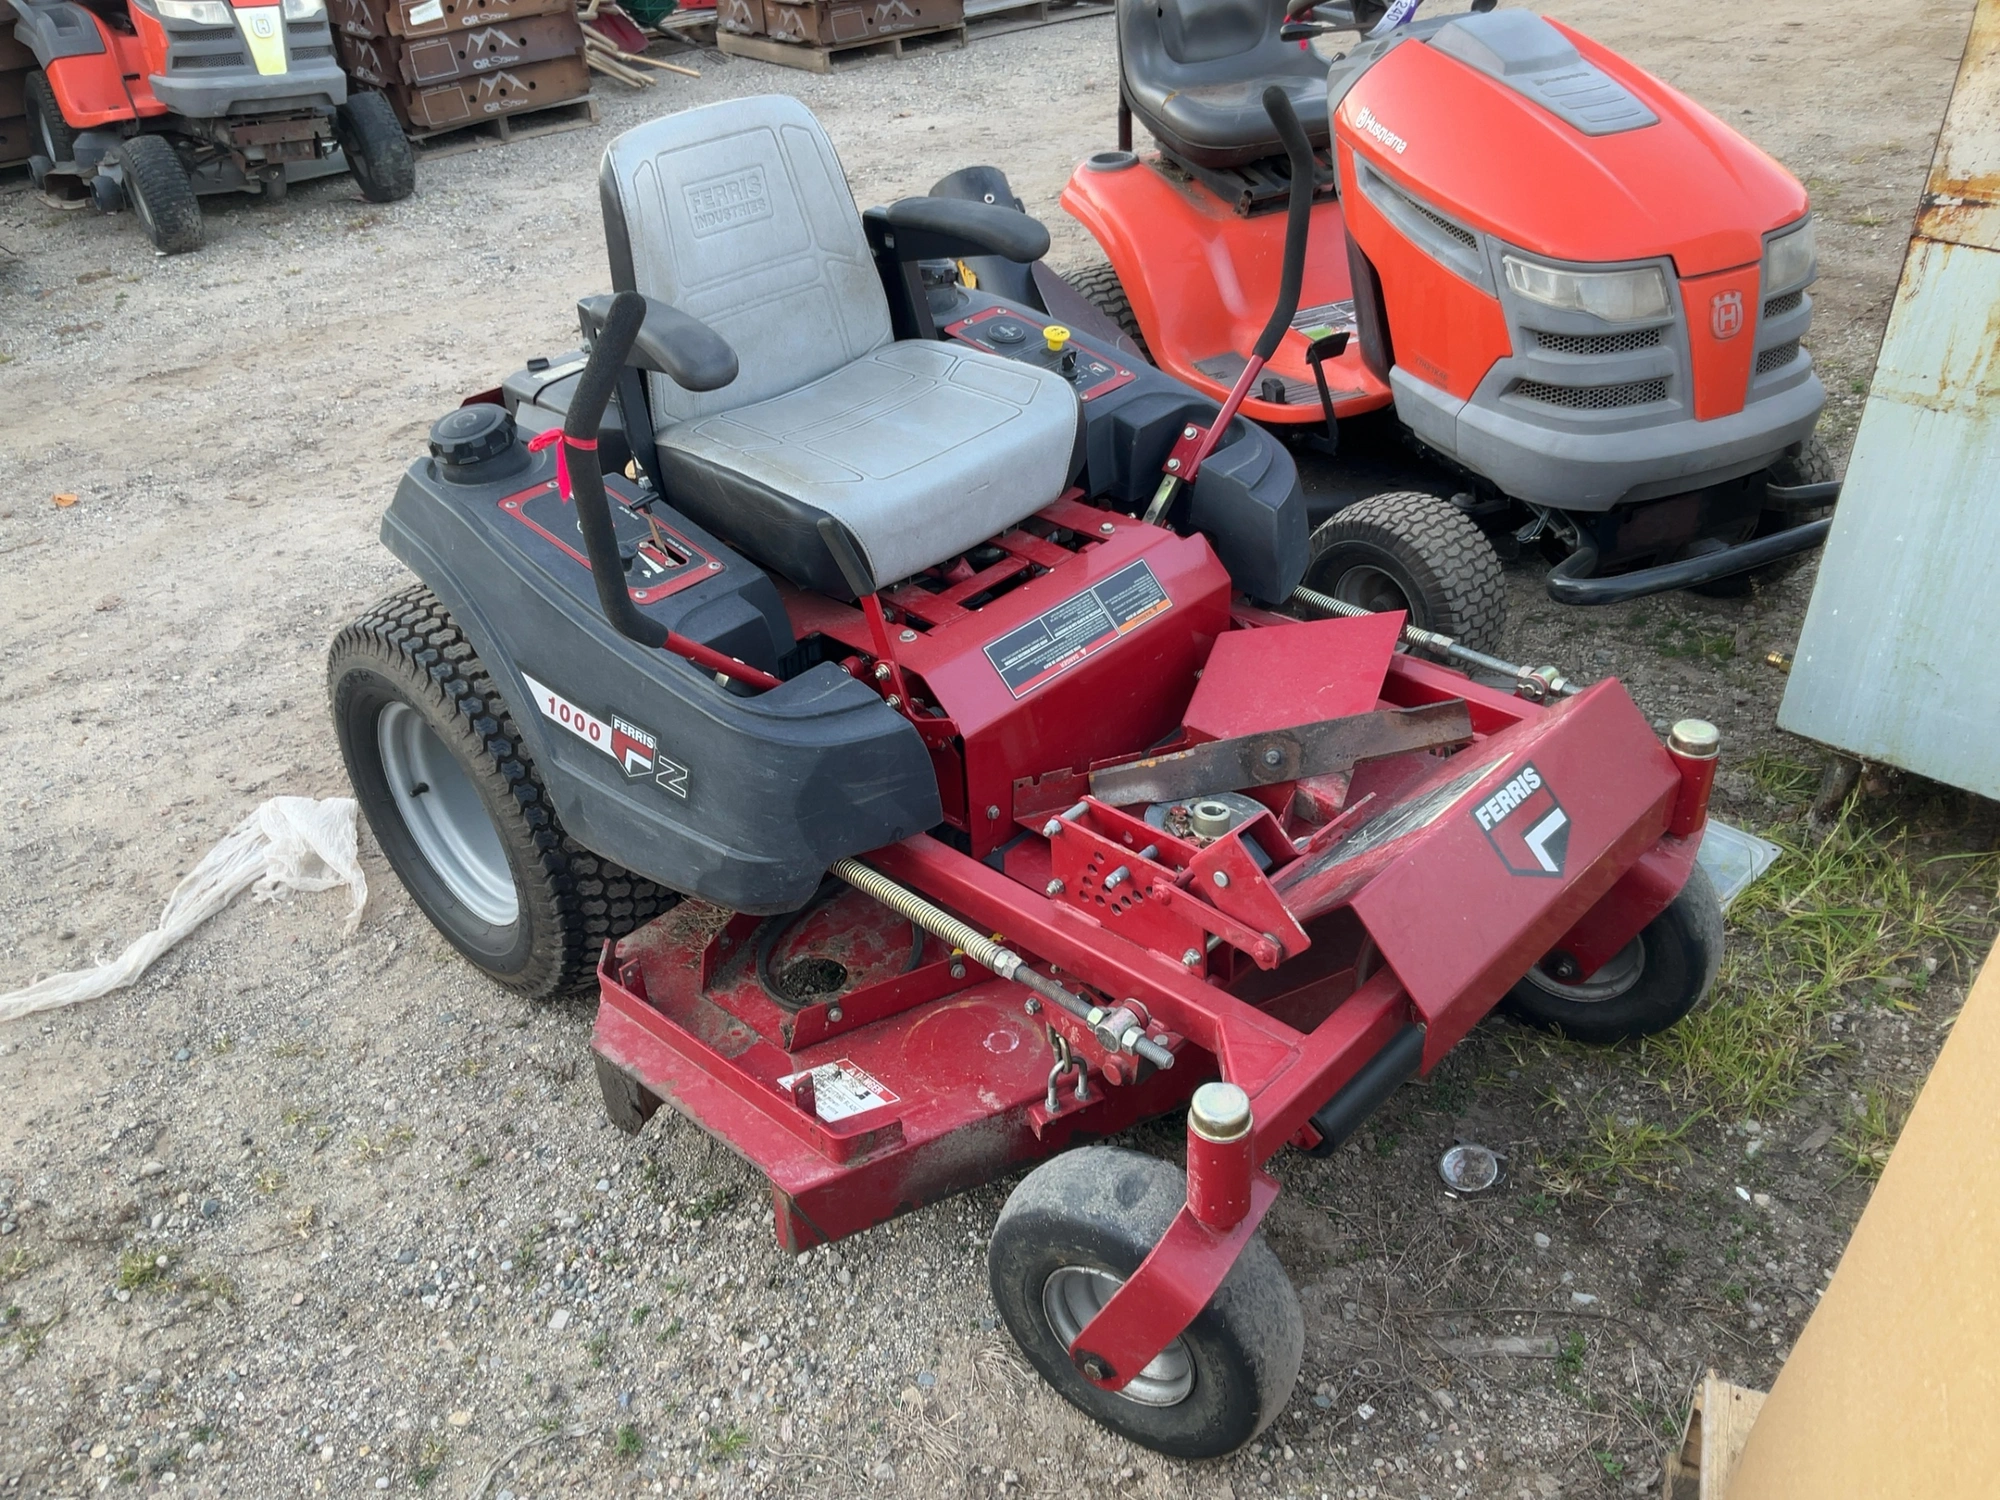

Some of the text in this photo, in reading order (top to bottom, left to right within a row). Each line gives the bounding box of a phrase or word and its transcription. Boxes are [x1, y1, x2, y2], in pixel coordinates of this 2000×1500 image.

[462, 15, 480, 26] QR
[473, 58, 491, 69] QR
[484, 102, 501, 113] QR
[1362, 112, 1408, 155] Husqvarna
[688, 175, 762, 214] FERRIS
[695, 198, 766, 230] INDUSTRIES
[548, 696, 602, 742] 1000
[613, 717, 655, 749] FERRIS
[1474, 767, 1541, 832] FERRIS
